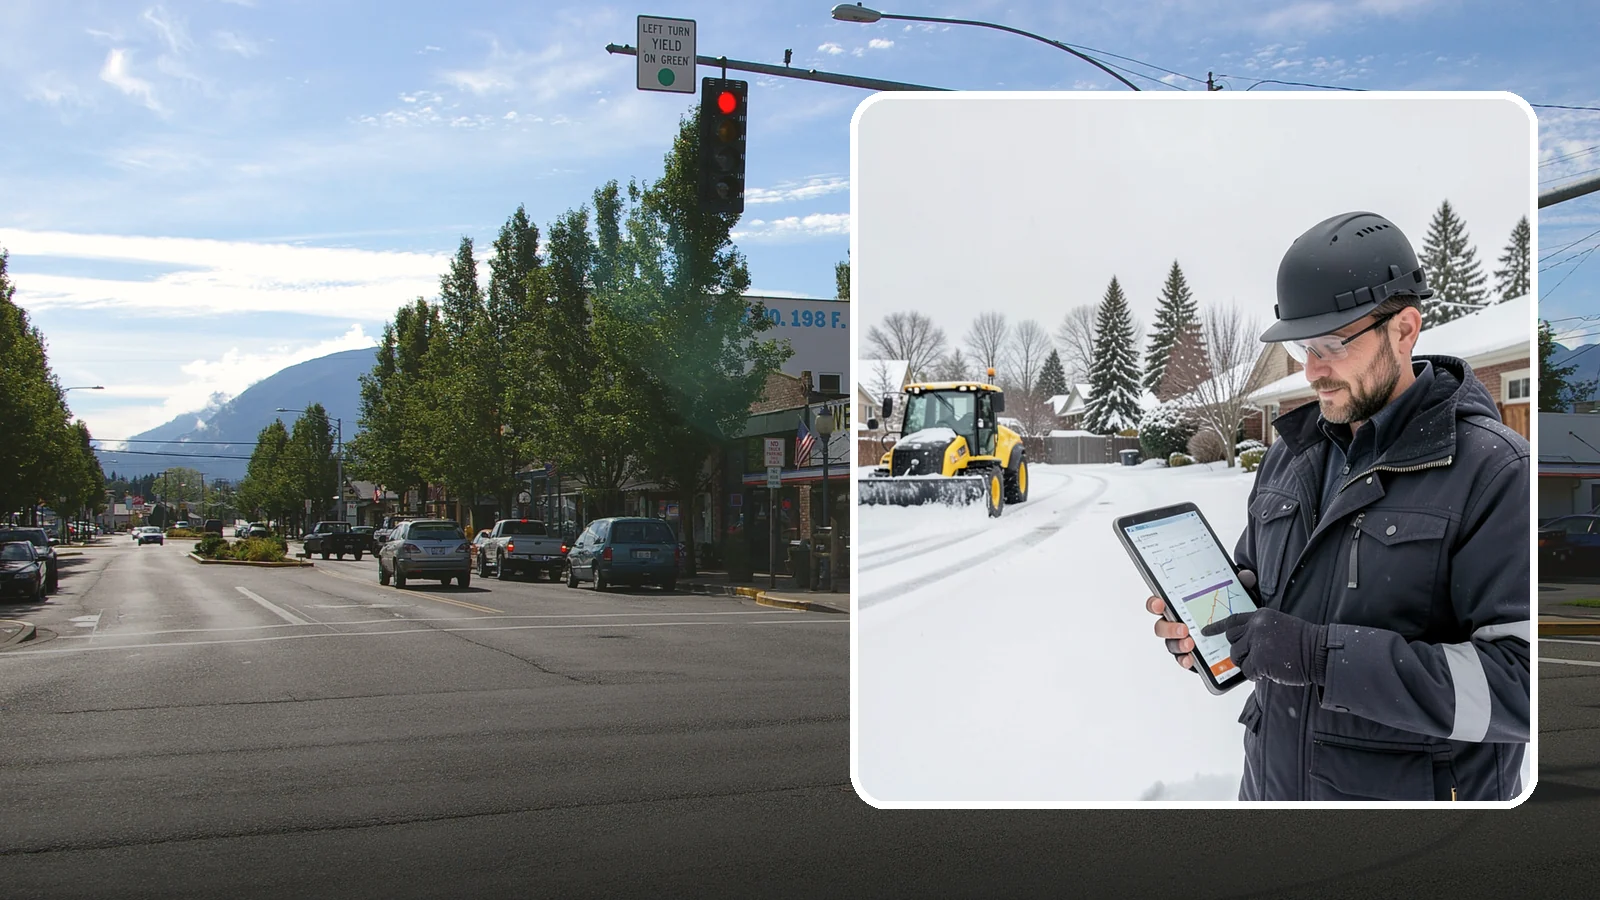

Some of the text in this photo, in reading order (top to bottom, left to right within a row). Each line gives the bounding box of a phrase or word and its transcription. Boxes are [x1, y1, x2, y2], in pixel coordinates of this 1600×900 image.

[643, 23, 690, 36] LEFT TURN
[652, 38, 682, 51] YIELD
[644, 53, 688, 66] ON GREEN
[791, 309, 826, 328] 198
[831, 311, 846, 329] F.
